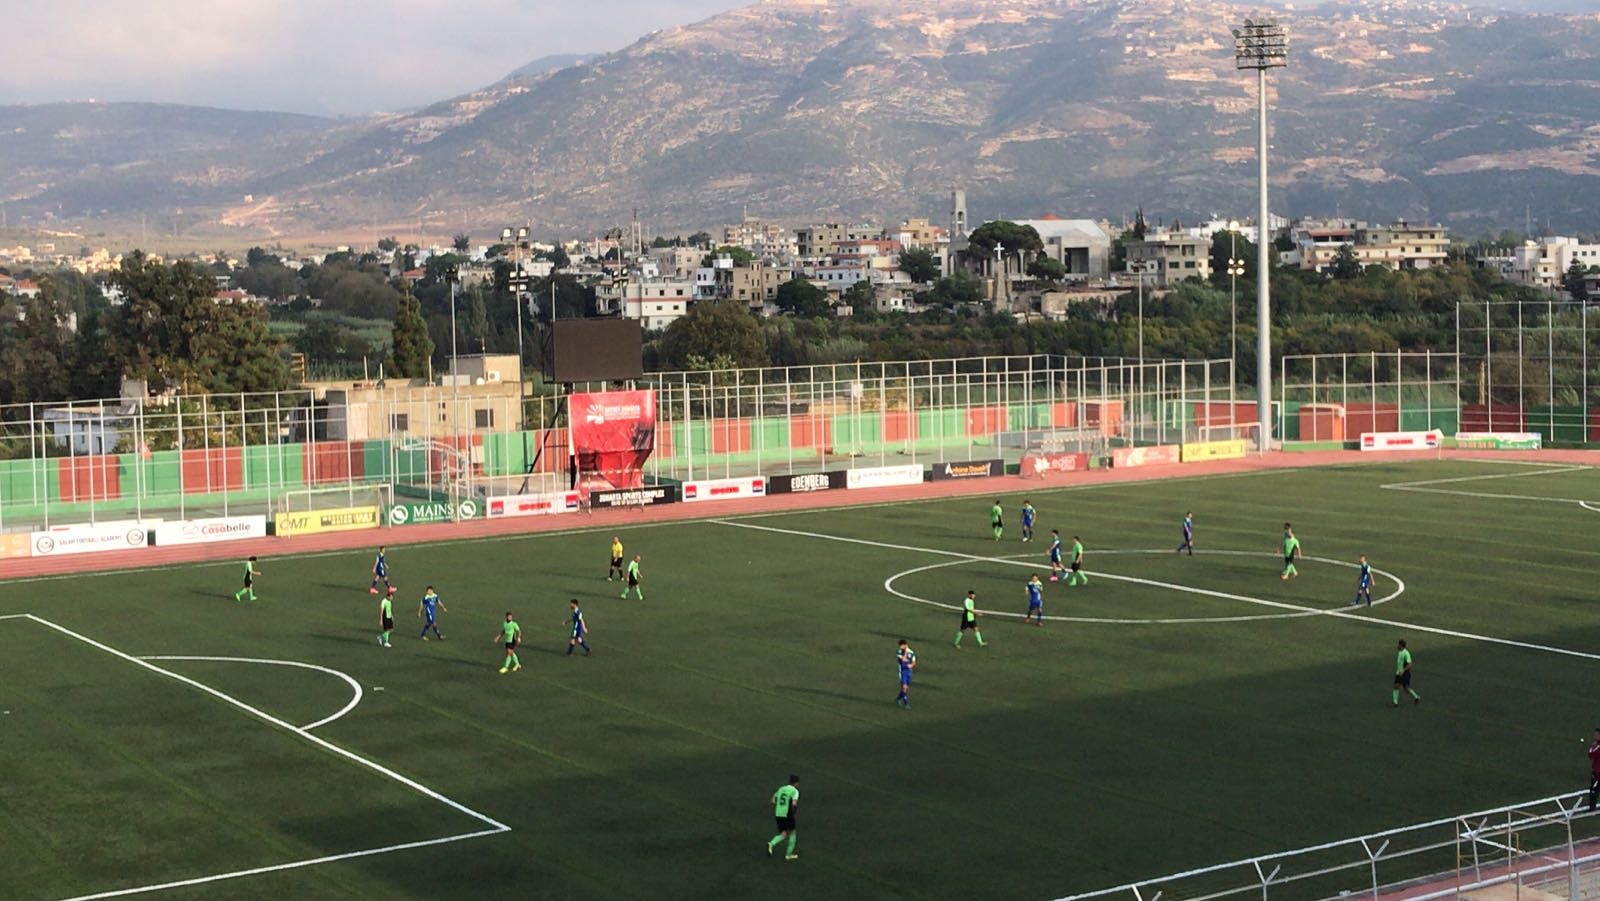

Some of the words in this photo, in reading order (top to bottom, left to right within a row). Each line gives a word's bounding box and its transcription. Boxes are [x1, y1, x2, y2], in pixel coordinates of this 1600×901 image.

[791, 474, 829, 488] EDENBERG
[643, 489, 665, 499] COMPLEX
[413, 503, 455, 518] MAINS
[201, 522, 251, 535] Casabelle
[780, 793, 787, 806] 5
